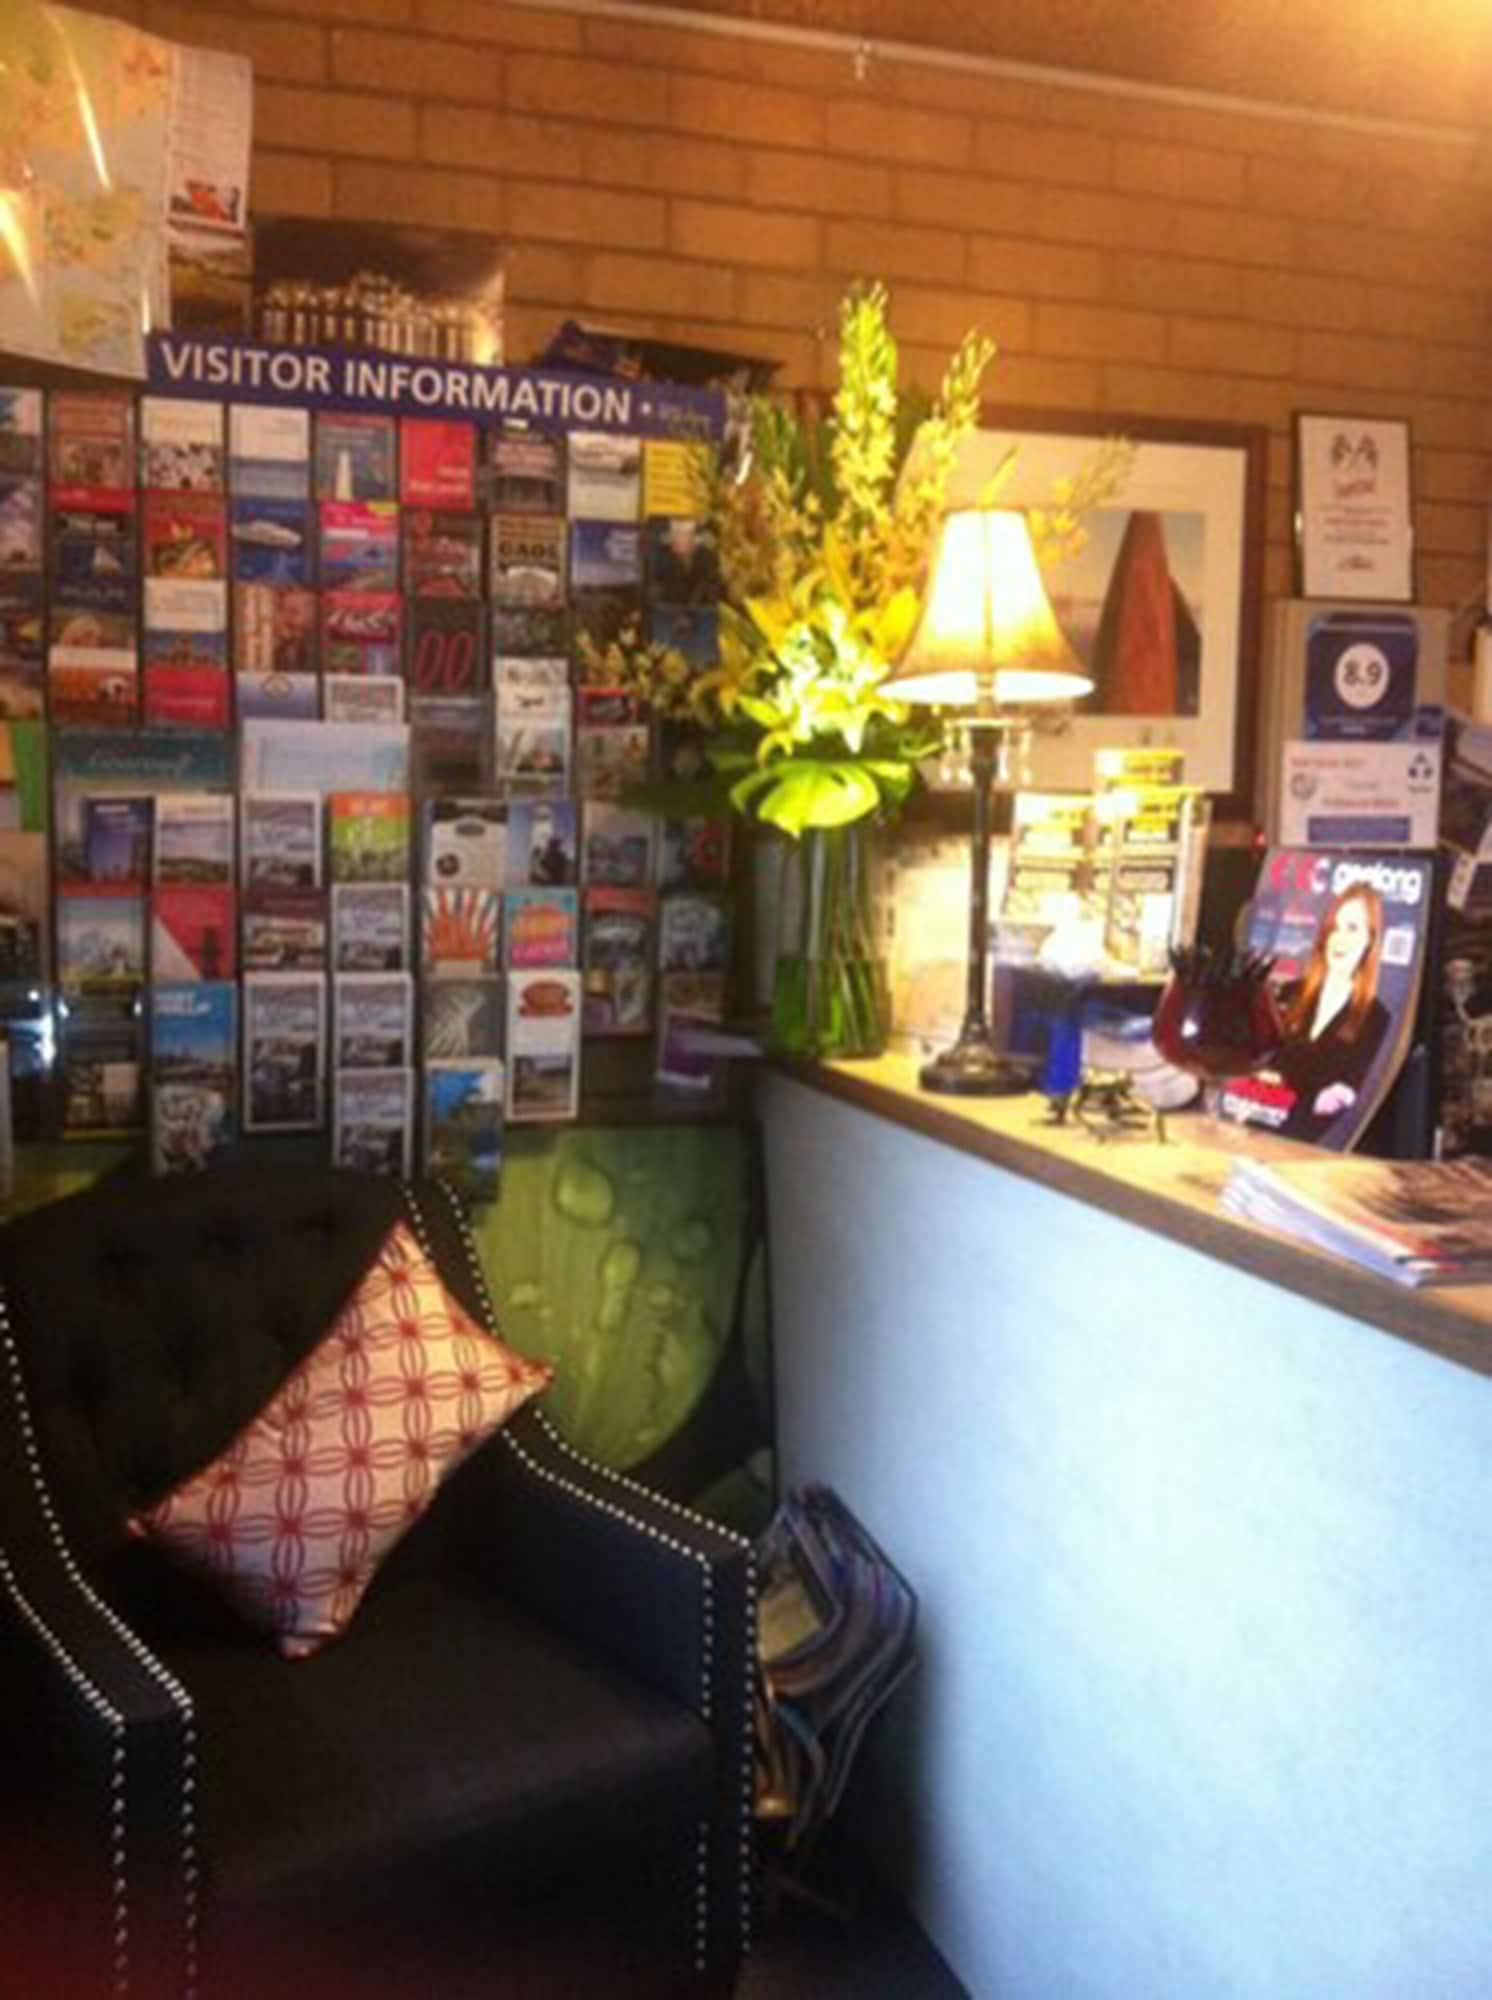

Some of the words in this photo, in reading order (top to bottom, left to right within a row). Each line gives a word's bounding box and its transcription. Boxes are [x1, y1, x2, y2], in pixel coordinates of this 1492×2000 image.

[161, 340, 331, 394] VISITOR
[345, 360, 631, 423] INFORMATION
[1342, 659, 1383, 687] 8.9
